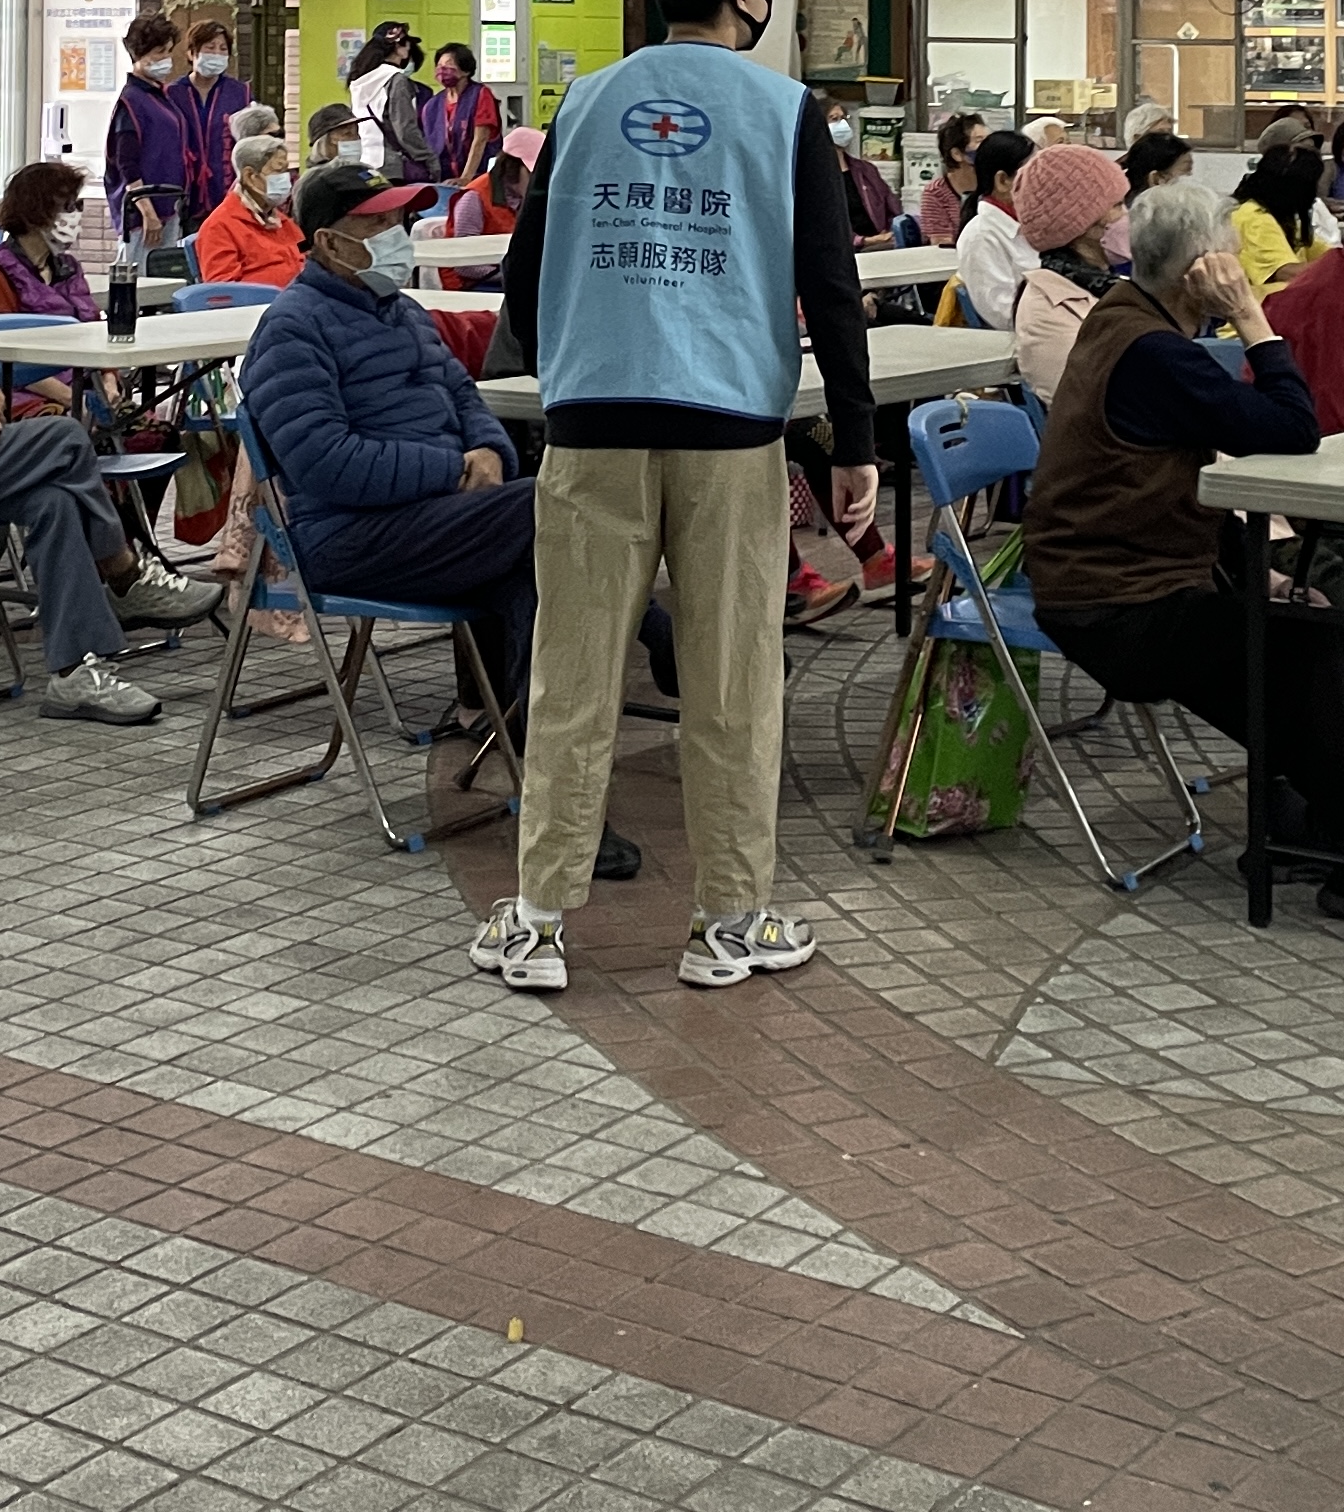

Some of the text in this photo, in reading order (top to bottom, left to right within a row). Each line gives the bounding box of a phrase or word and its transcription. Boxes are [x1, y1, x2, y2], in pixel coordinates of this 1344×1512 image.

[592, 182, 732, 219] 天晟醫院
[640, 217, 683, 232] General
[687, 222, 732, 236] Hospital
[590, 241, 728, 276] 志願服務隊
[623, 273, 685, 289] Volunteer
[763, 924, 777, 943] N
